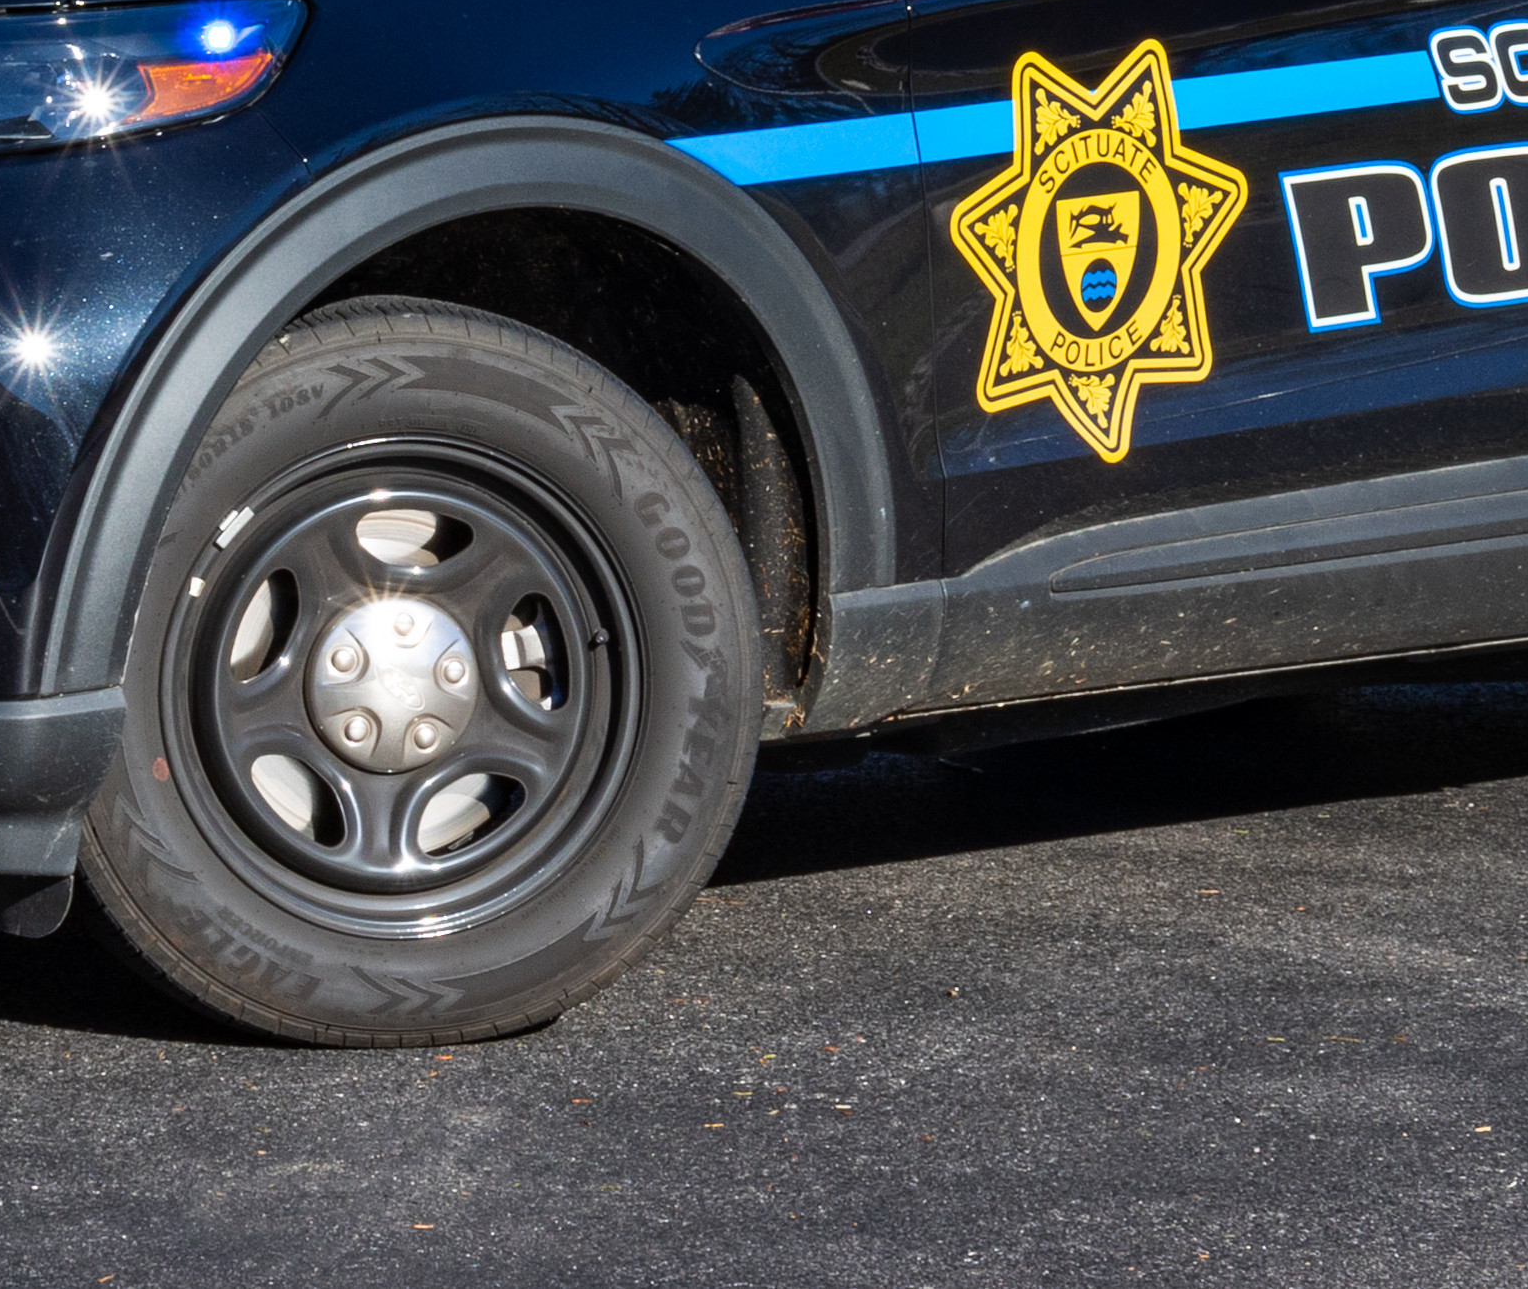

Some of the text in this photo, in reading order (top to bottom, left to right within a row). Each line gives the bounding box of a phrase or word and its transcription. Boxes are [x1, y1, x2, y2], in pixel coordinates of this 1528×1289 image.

[1039, 134, 1157, 195] SCITUATE
[1050, 322, 1143, 367] POLICE
[634, 491, 729, 845] GOODYEAR
[178, 905, 321, 1003] EAGLE
